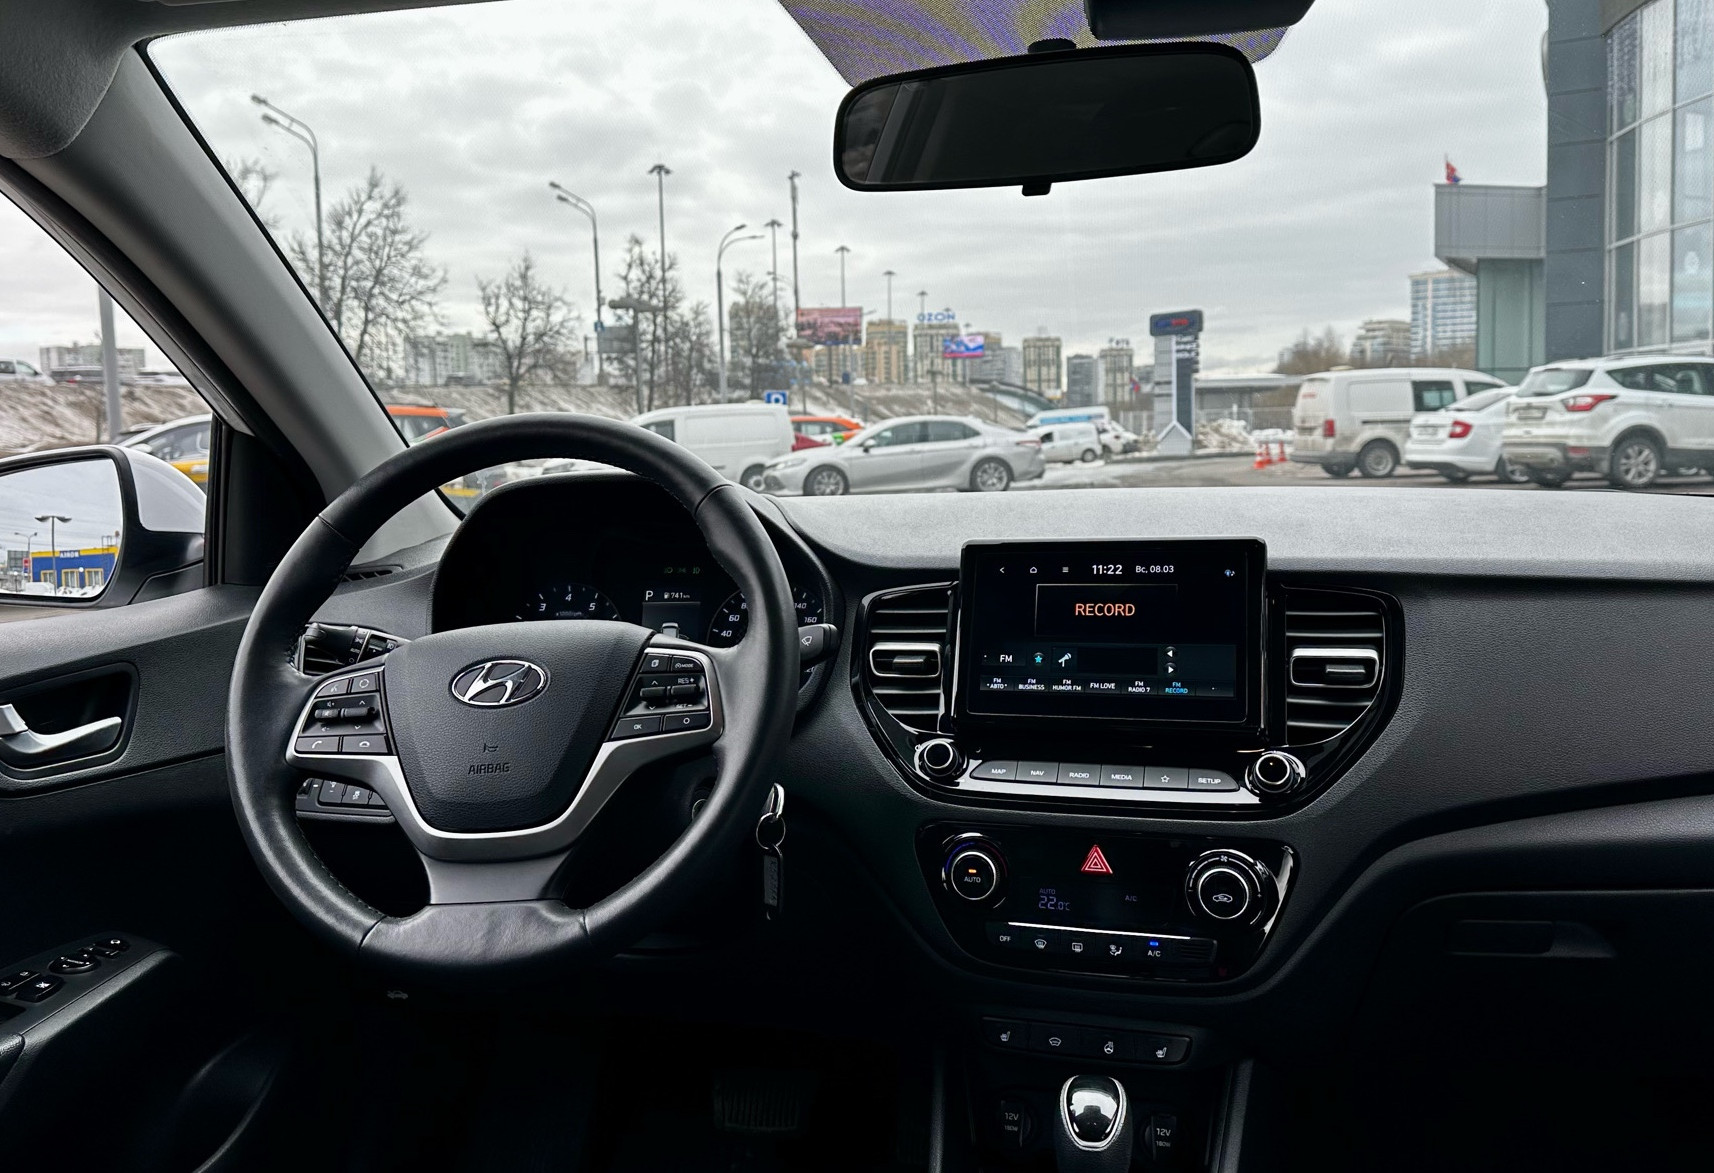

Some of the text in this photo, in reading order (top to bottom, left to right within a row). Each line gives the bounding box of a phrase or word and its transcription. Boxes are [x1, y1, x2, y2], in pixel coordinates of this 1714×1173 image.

[917, 312, 955, 321] OZON
[1092, 564, 1123, 575] 11:22
[1149, 565, 1175, 573] 08.03
[565, 593, 572, 601] 4
[645, 590, 654, 601] P
[538, 603, 547, 612] 3
[588, 602, 596, 611] 5
[1075, 603, 1136, 617] RECORD
[728, 614, 740, 622] 60
[1000, 654, 1013, 663] FM
[468, 762, 510, 775] AIRBAG
[991, 767, 1007, 775] MAP
[1069, 771, 1090, 779] RADIO
[1111, 773, 1132, 781] MEDIA
[1198, 777, 1222, 785] SETUP
[1039, 887, 1056, 895] AUTO
[1124, 894, 1138, 902] A/C
[999, 935, 1012, 943] OFF
[1147, 949, 1161, 958] A/C
[1004, 1112, 1019, 1121] 12V
[1156, 1128, 1171, 1137] 12V
